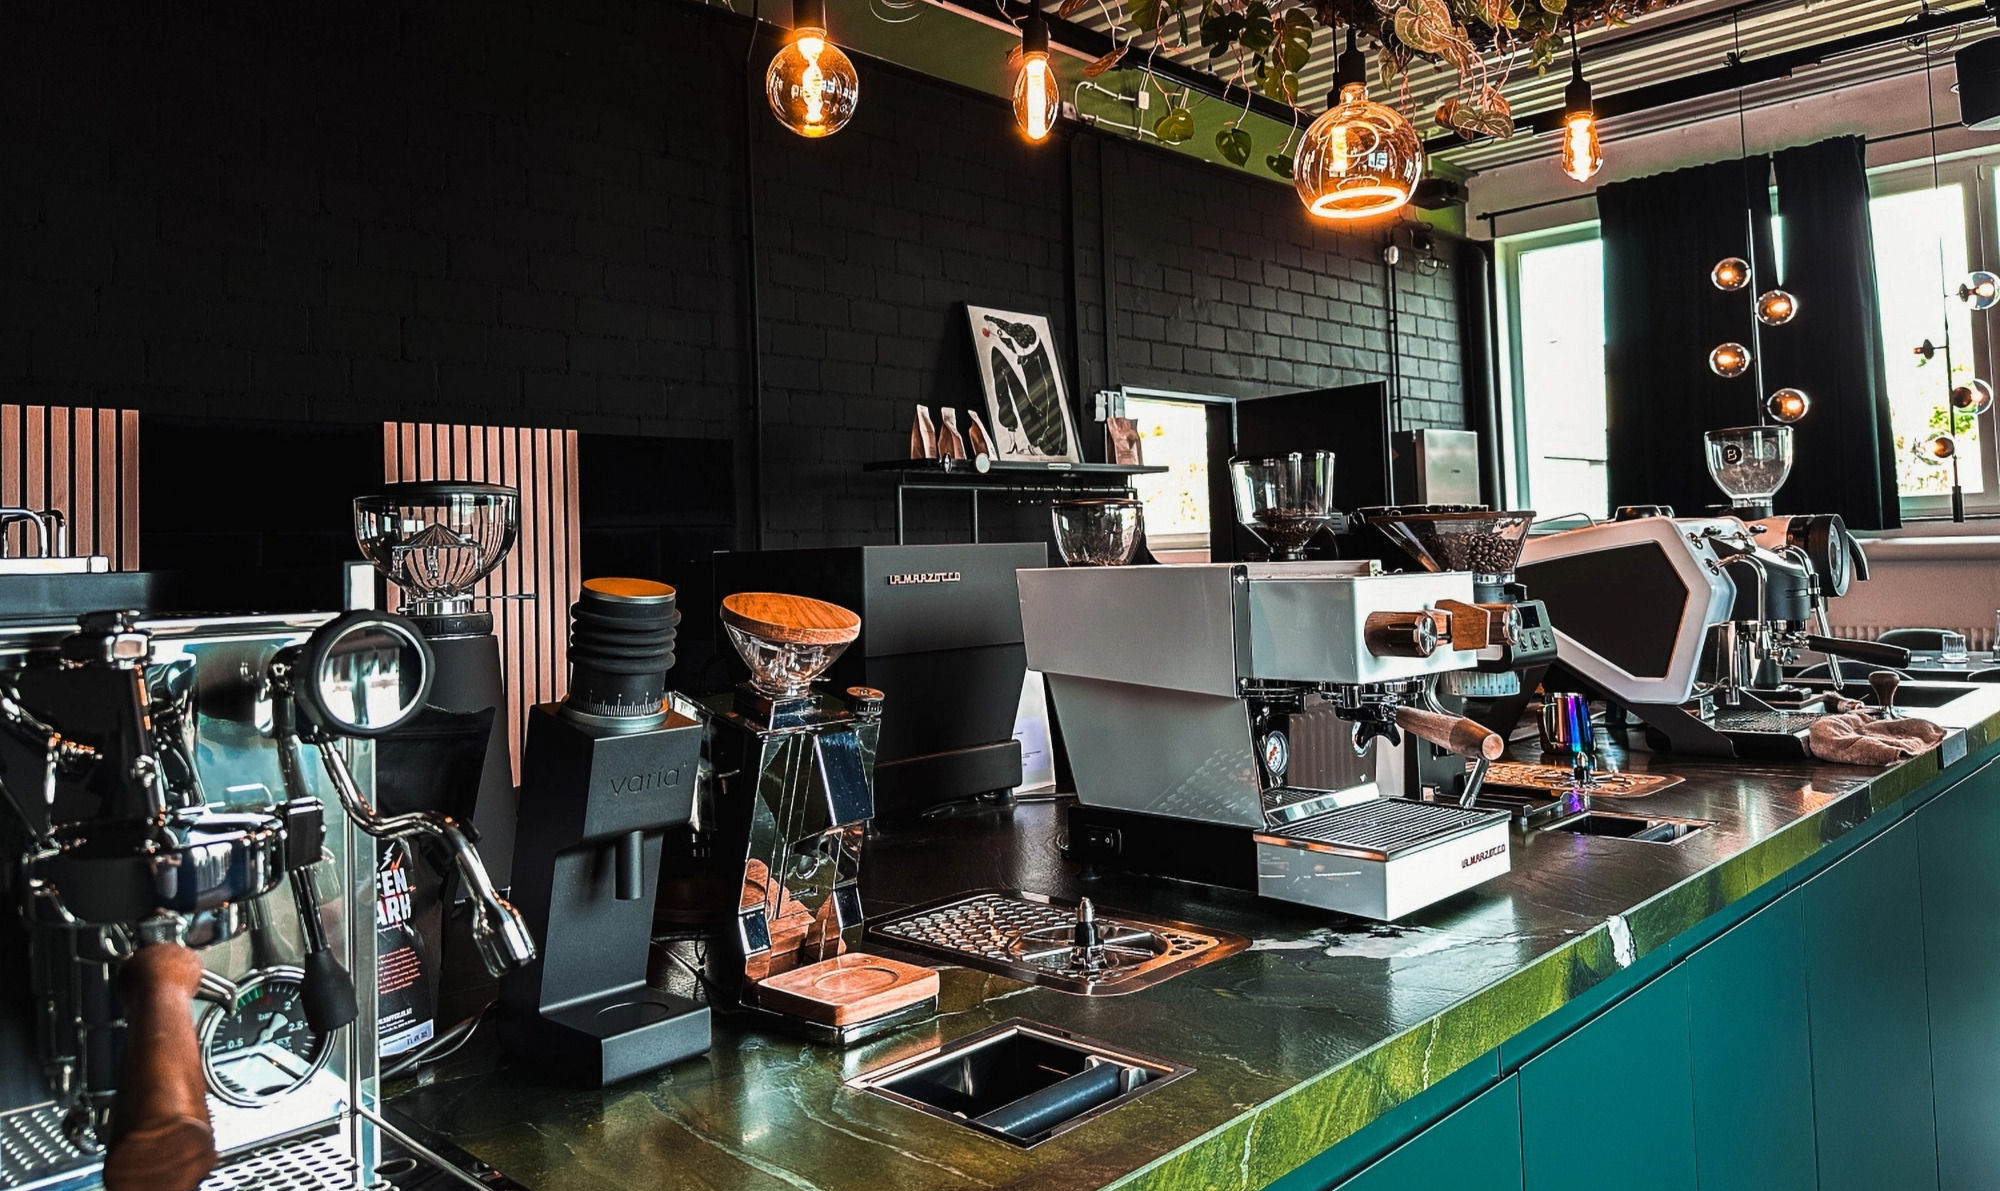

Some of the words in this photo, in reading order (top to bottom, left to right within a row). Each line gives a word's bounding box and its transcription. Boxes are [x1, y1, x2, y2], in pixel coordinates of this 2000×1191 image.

[284, 1001, 292, 1011] 2
[288, 1020, 304, 1033] 2.5
[227, 1037, 244, 1049] 0.5
